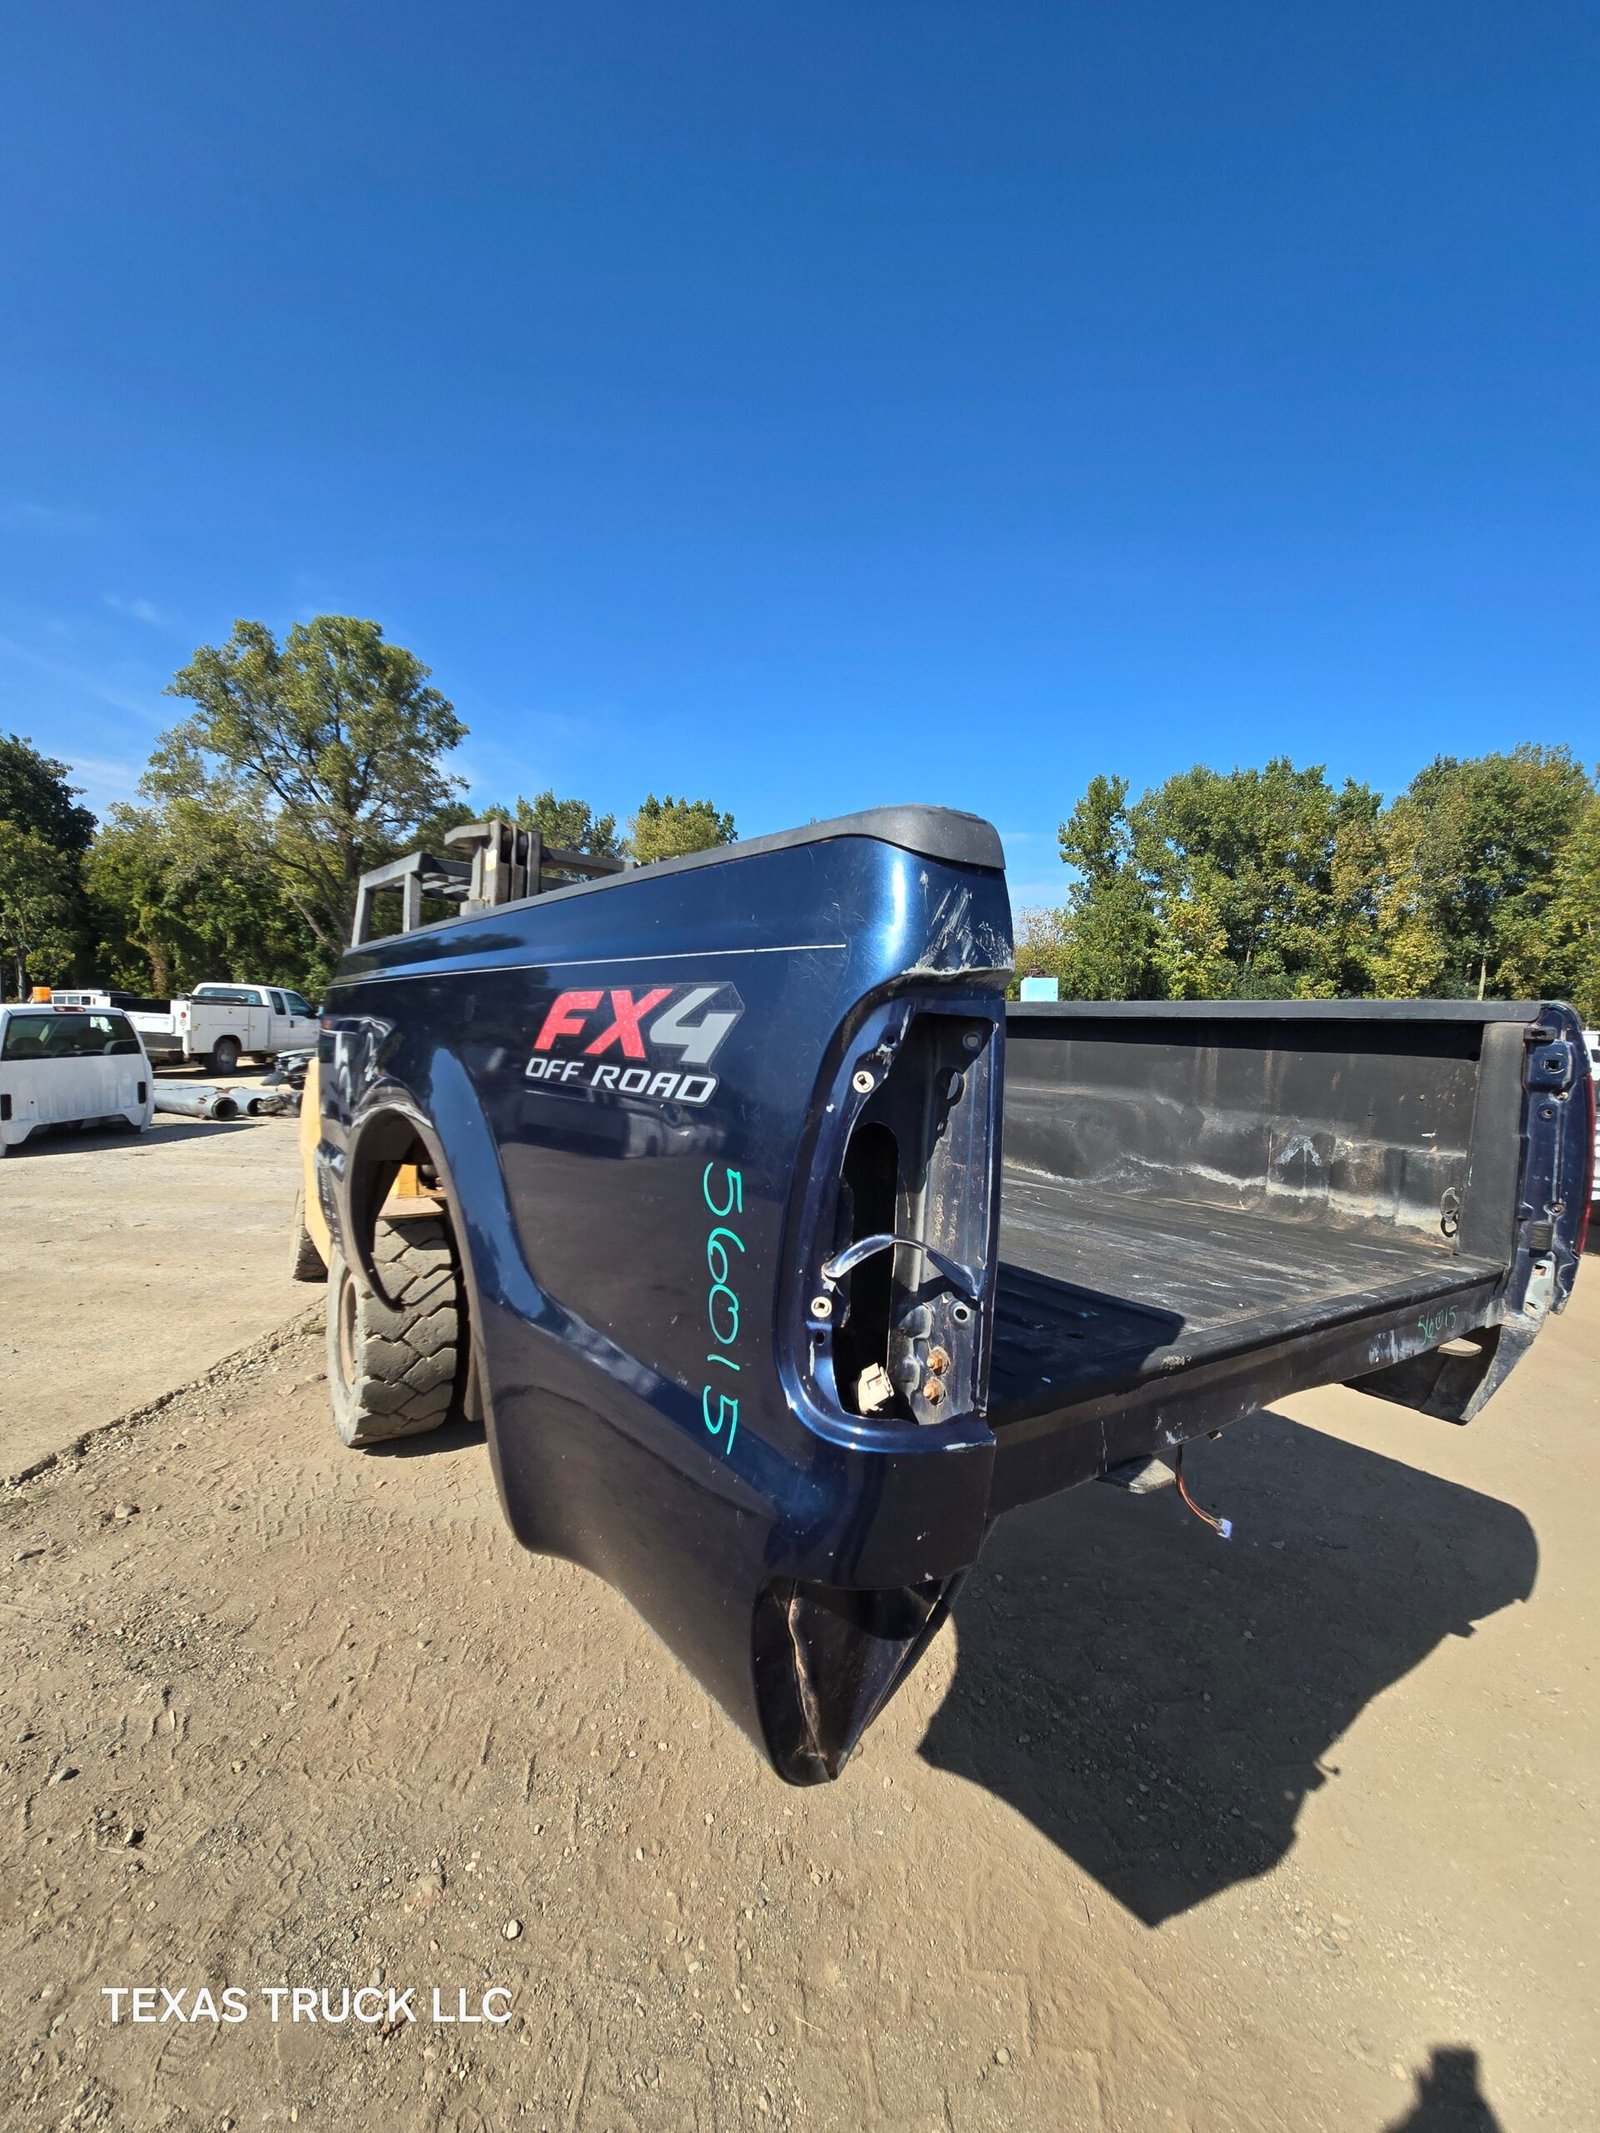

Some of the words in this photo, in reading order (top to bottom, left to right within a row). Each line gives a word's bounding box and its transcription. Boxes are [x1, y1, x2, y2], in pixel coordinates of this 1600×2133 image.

[533, 987, 738, 1064] FX4
[525, 1057, 585, 1082] OFF
[590, 1064, 717, 1103] ROAD
[702, 1161, 746, 1456] 56015
